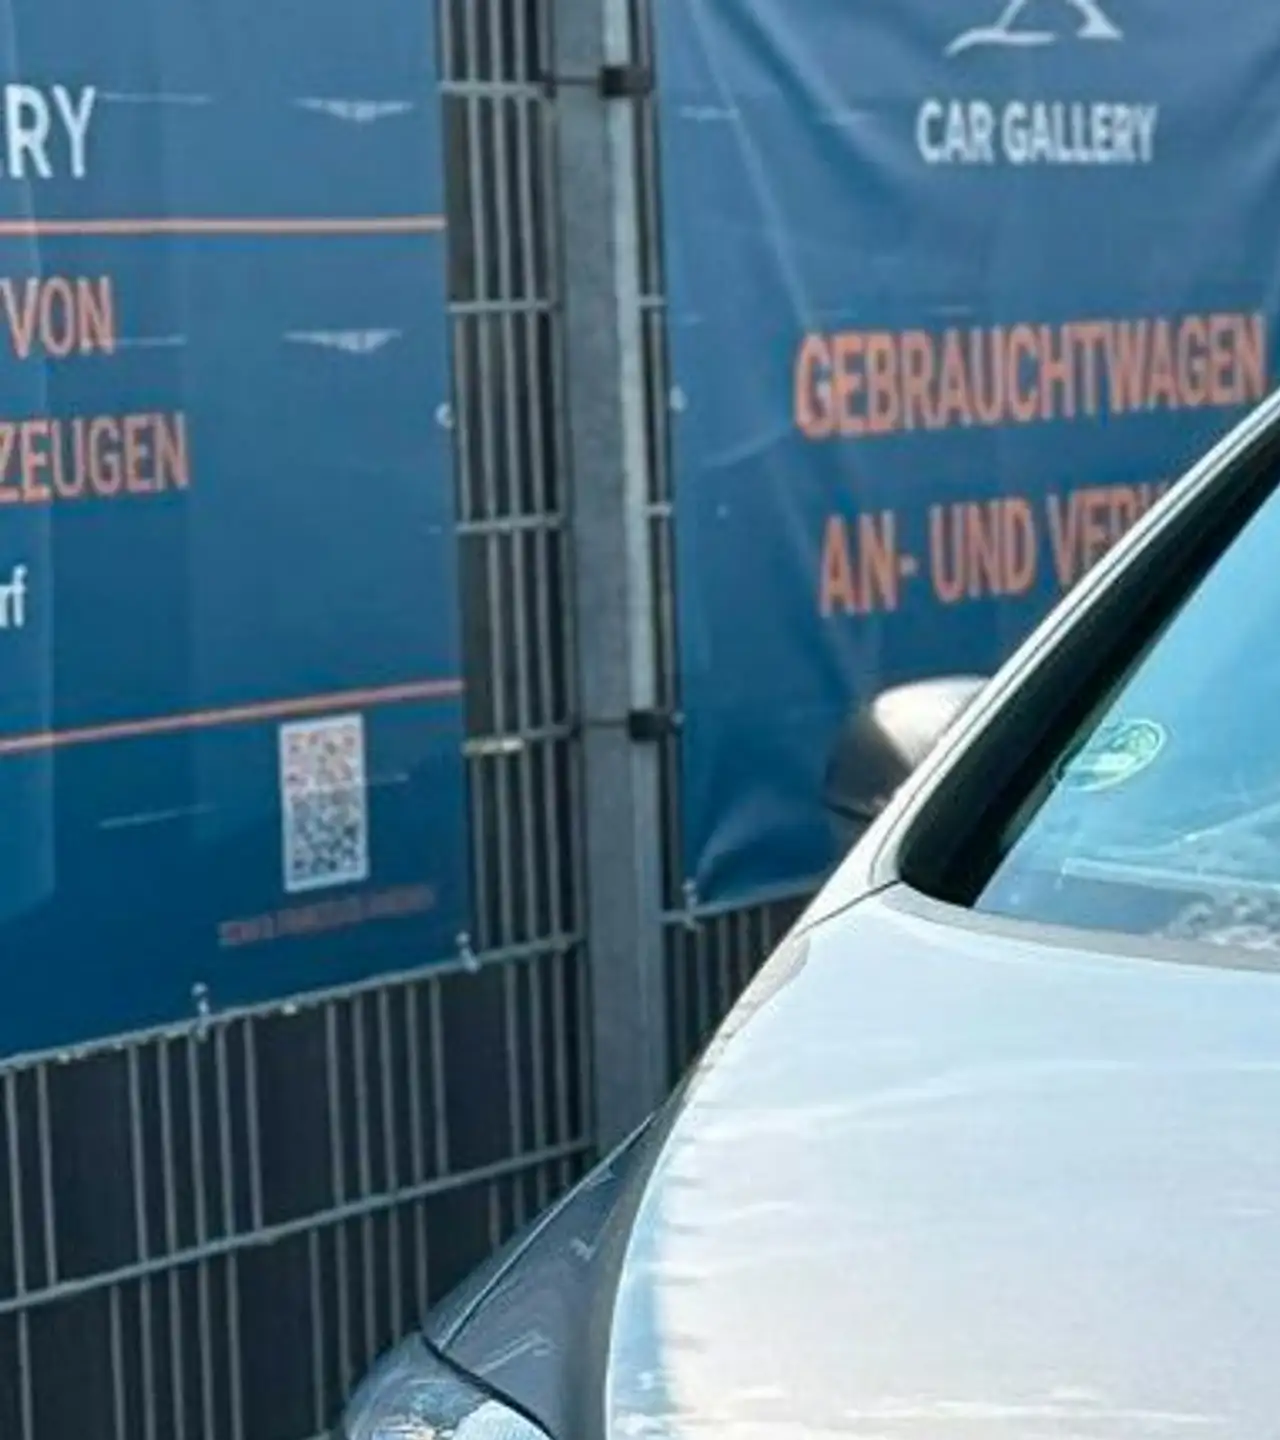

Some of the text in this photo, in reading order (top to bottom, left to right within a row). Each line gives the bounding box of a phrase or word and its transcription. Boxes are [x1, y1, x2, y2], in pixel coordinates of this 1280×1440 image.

[0, 82, 97, 179] RY
[916, 97, 1160, 164] CAR GALLERY
[0, 274, 115, 359] VON
[794, 314, 1268, 438] GEBRAUCHTWAGEN
[820, 508, 919, 617] AN-
[928, 497, 1037, 602] UND
